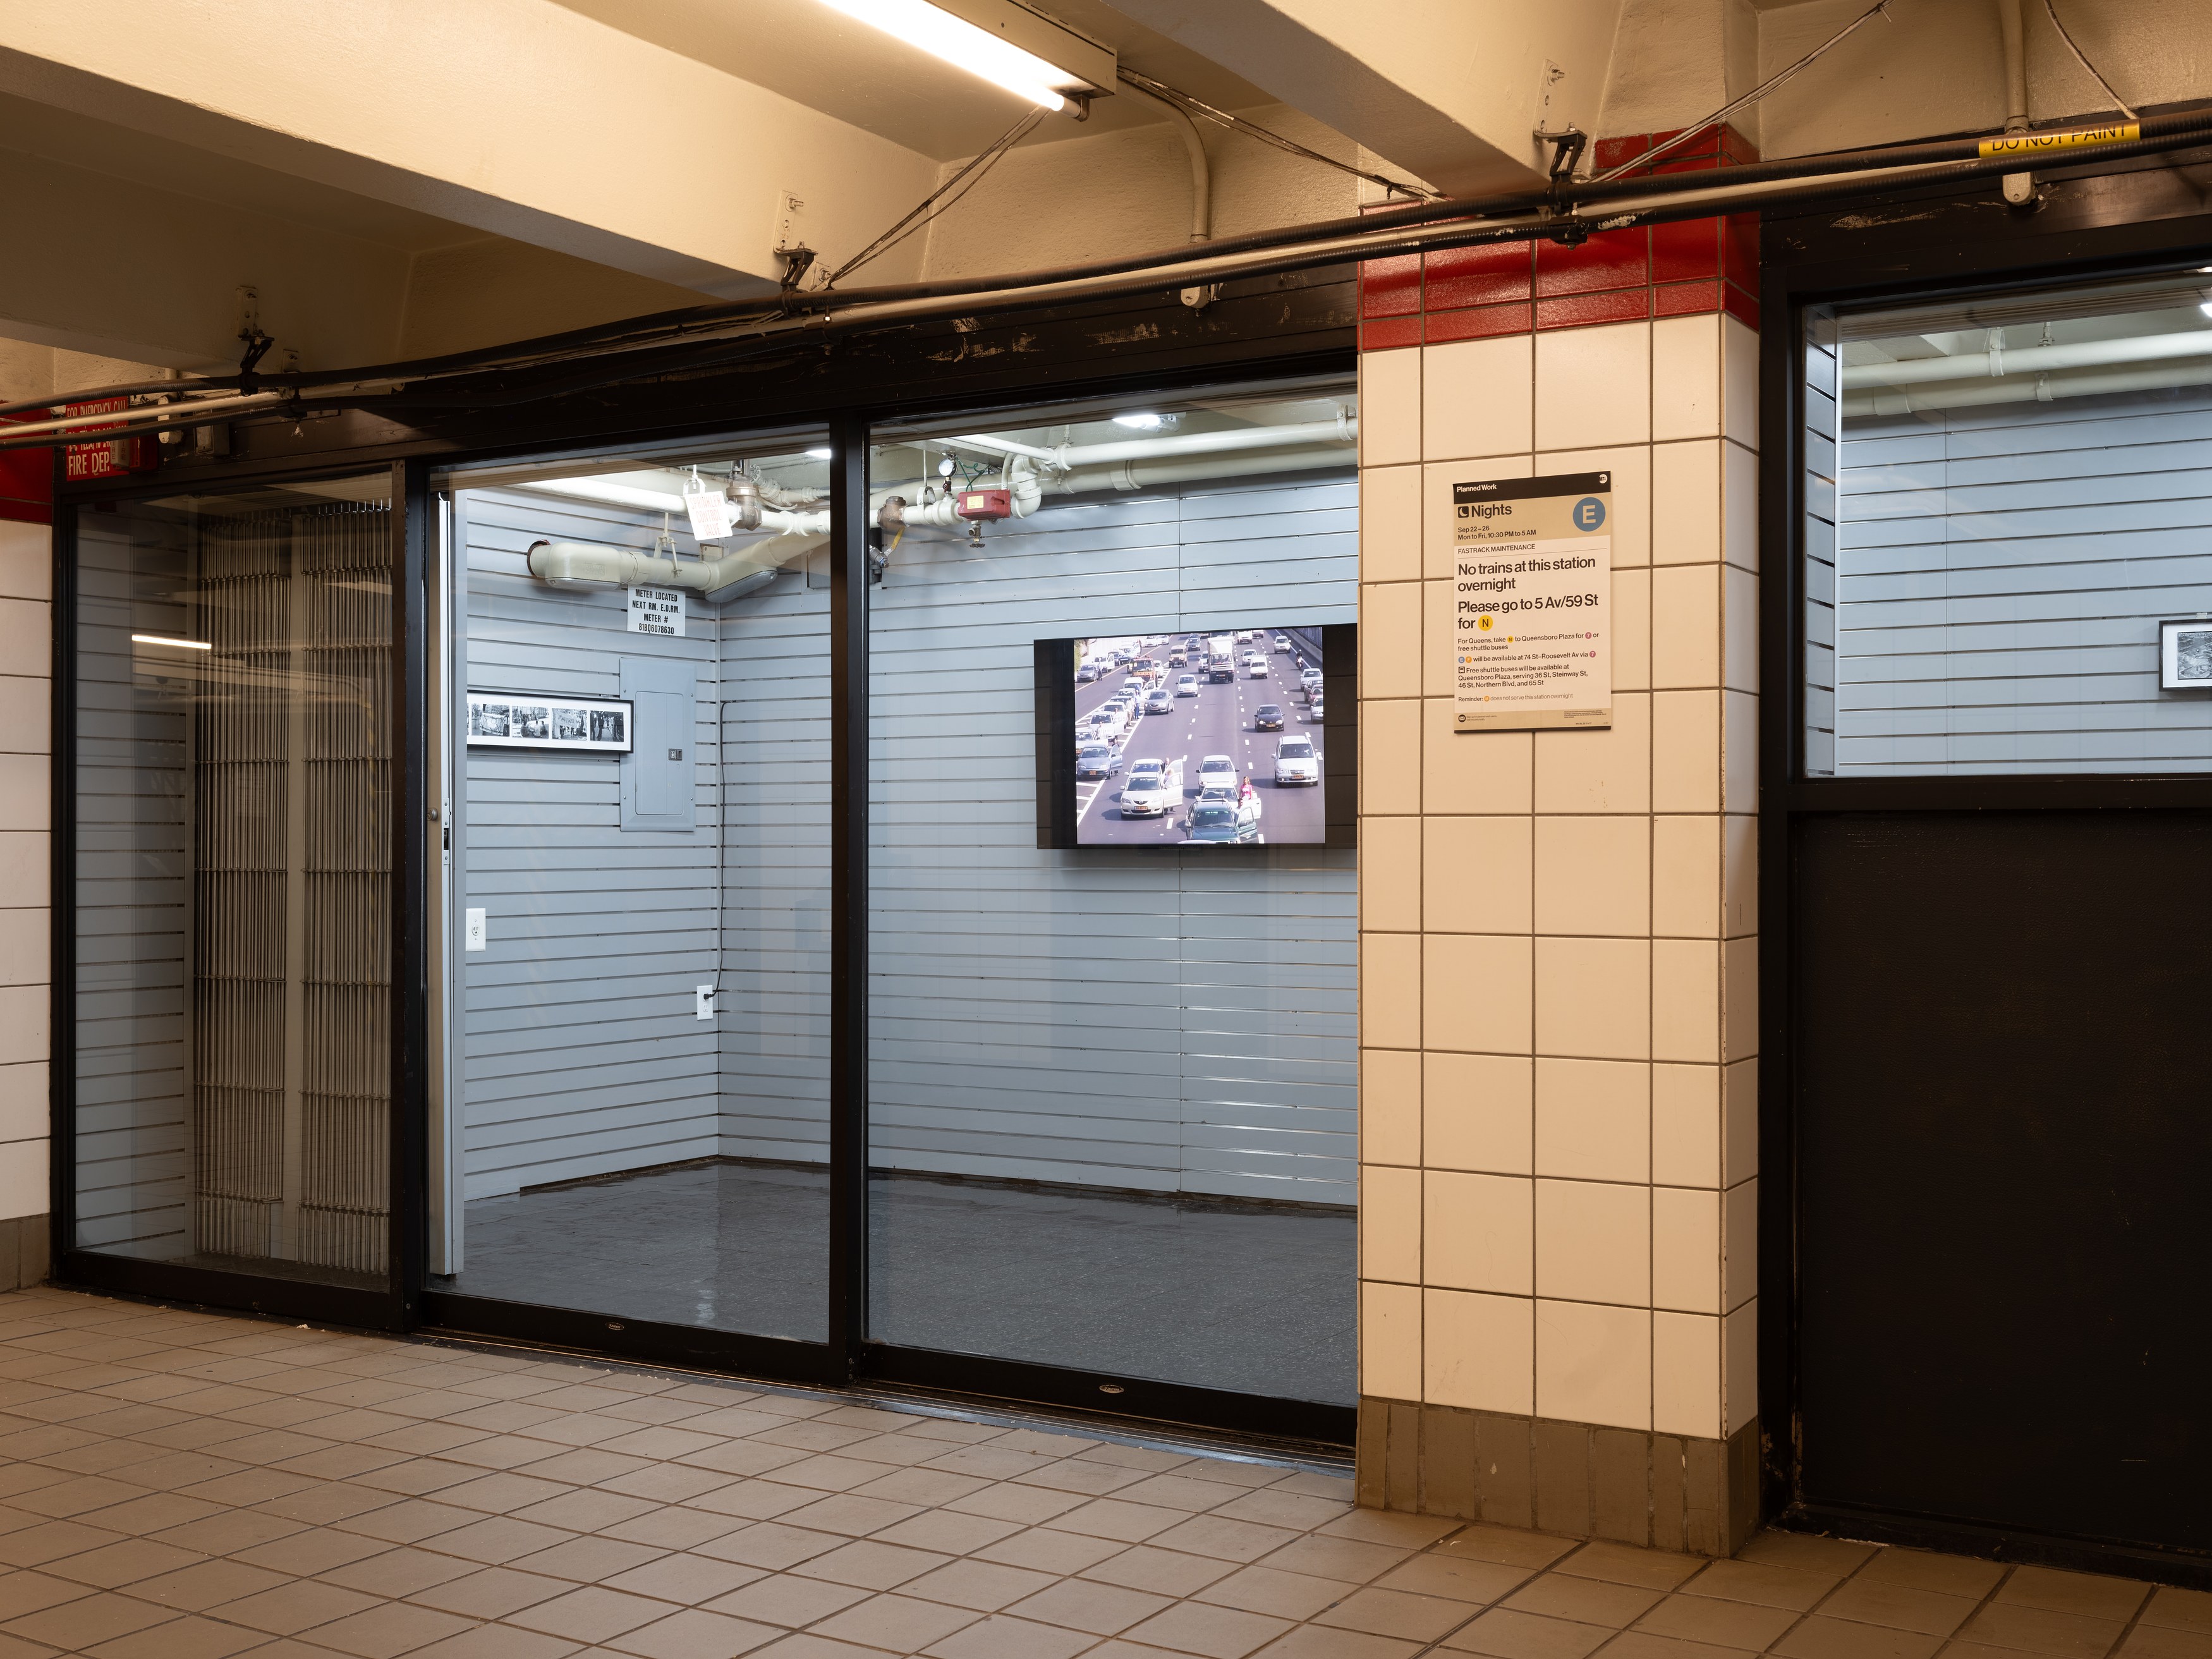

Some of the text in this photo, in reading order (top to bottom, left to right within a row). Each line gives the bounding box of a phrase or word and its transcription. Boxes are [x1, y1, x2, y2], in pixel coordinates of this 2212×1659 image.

[1992, 138, 2019, 151] DO
[69, 452, 110, 475] FIRE DEP.
[690, 495, 722, 509] SPRINKLER
[696, 509, 722, 523] CONTROL
[1471, 504, 1512, 519] Nights
[1583, 505, 1596, 524] E
[704, 523, 721, 537] VALVE
[1458, 556, 1596, 576] No trains at this station
[1458, 578, 1516, 592] overnight
[635, 589, 678, 602] METER LOCATED
[632, 600, 680, 614] NEXT RM. E.D.RM.
[1458, 594, 1598, 613] Please go to 5 Av/59 St
[643, 613, 661, 623] METER
[1458, 617, 1489, 629] for N
[639, 623, 674, 635] 81BQ6078630
